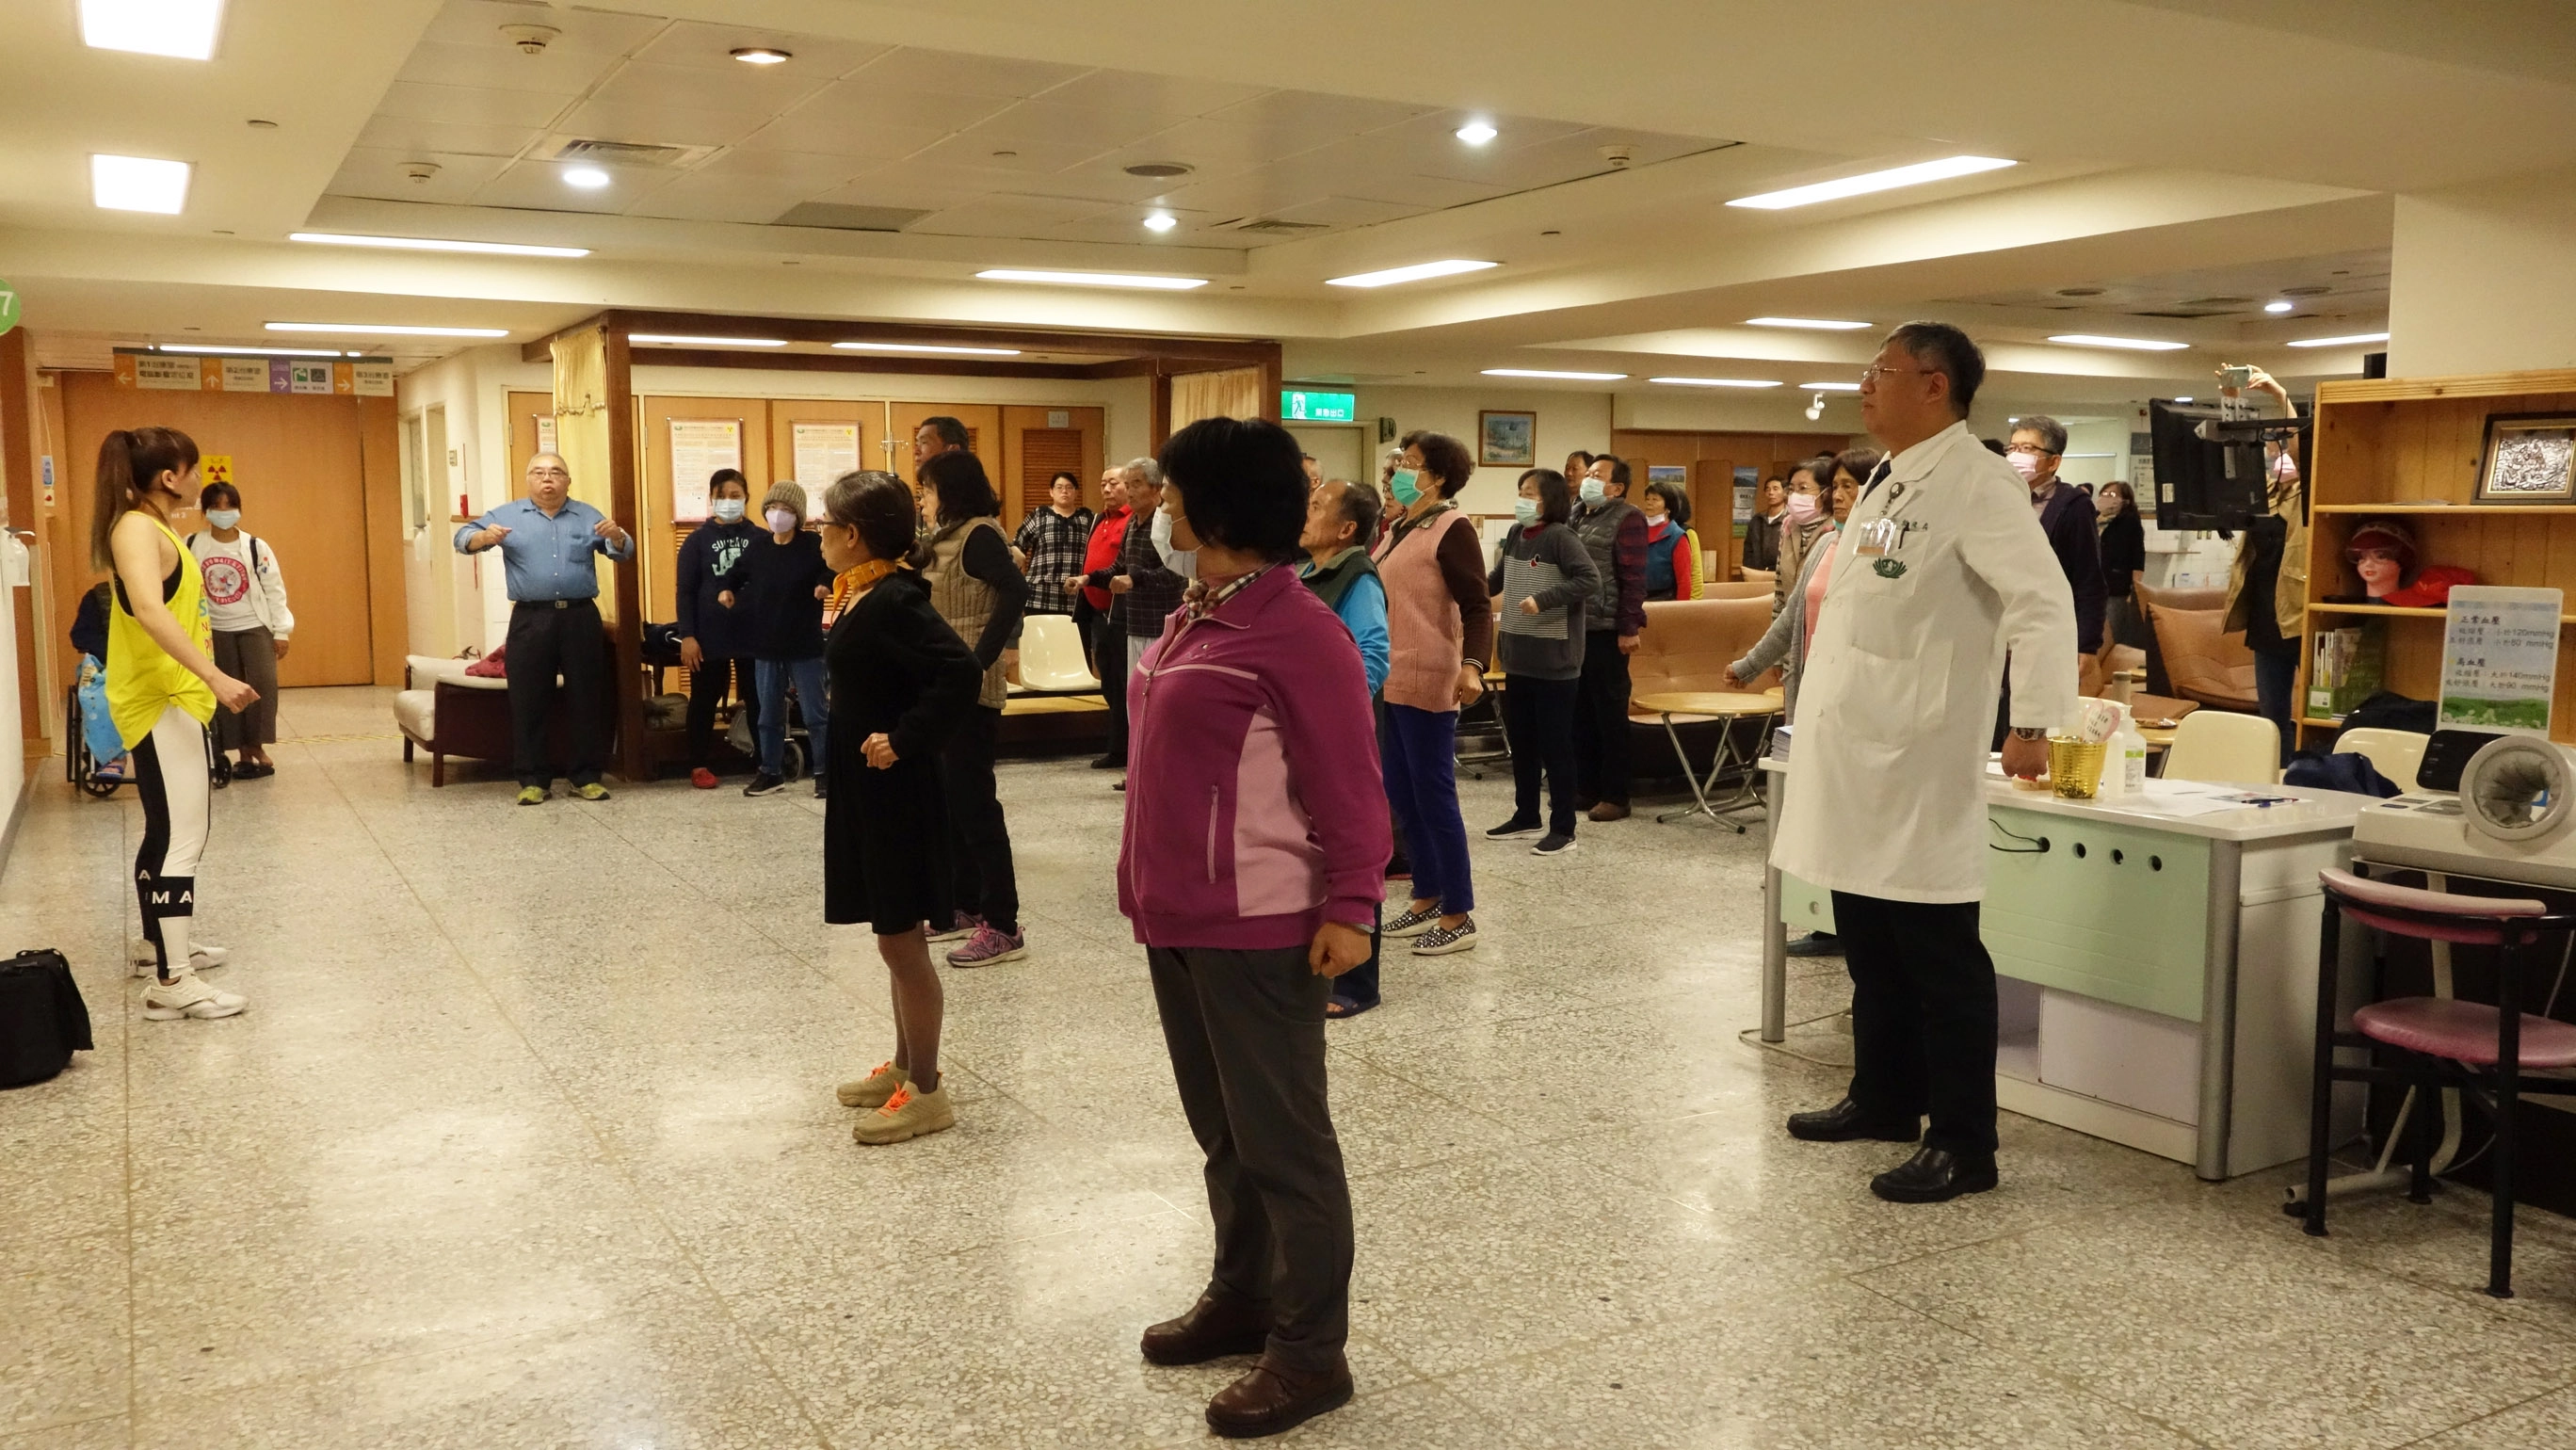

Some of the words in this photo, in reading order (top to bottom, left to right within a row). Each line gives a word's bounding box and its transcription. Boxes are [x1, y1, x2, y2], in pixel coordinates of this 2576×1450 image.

[0, 291, 13, 316] 7
[2460, 616, 2501, 625] 正常血壓
[2455, 657, 2486, 668] 高血壓
